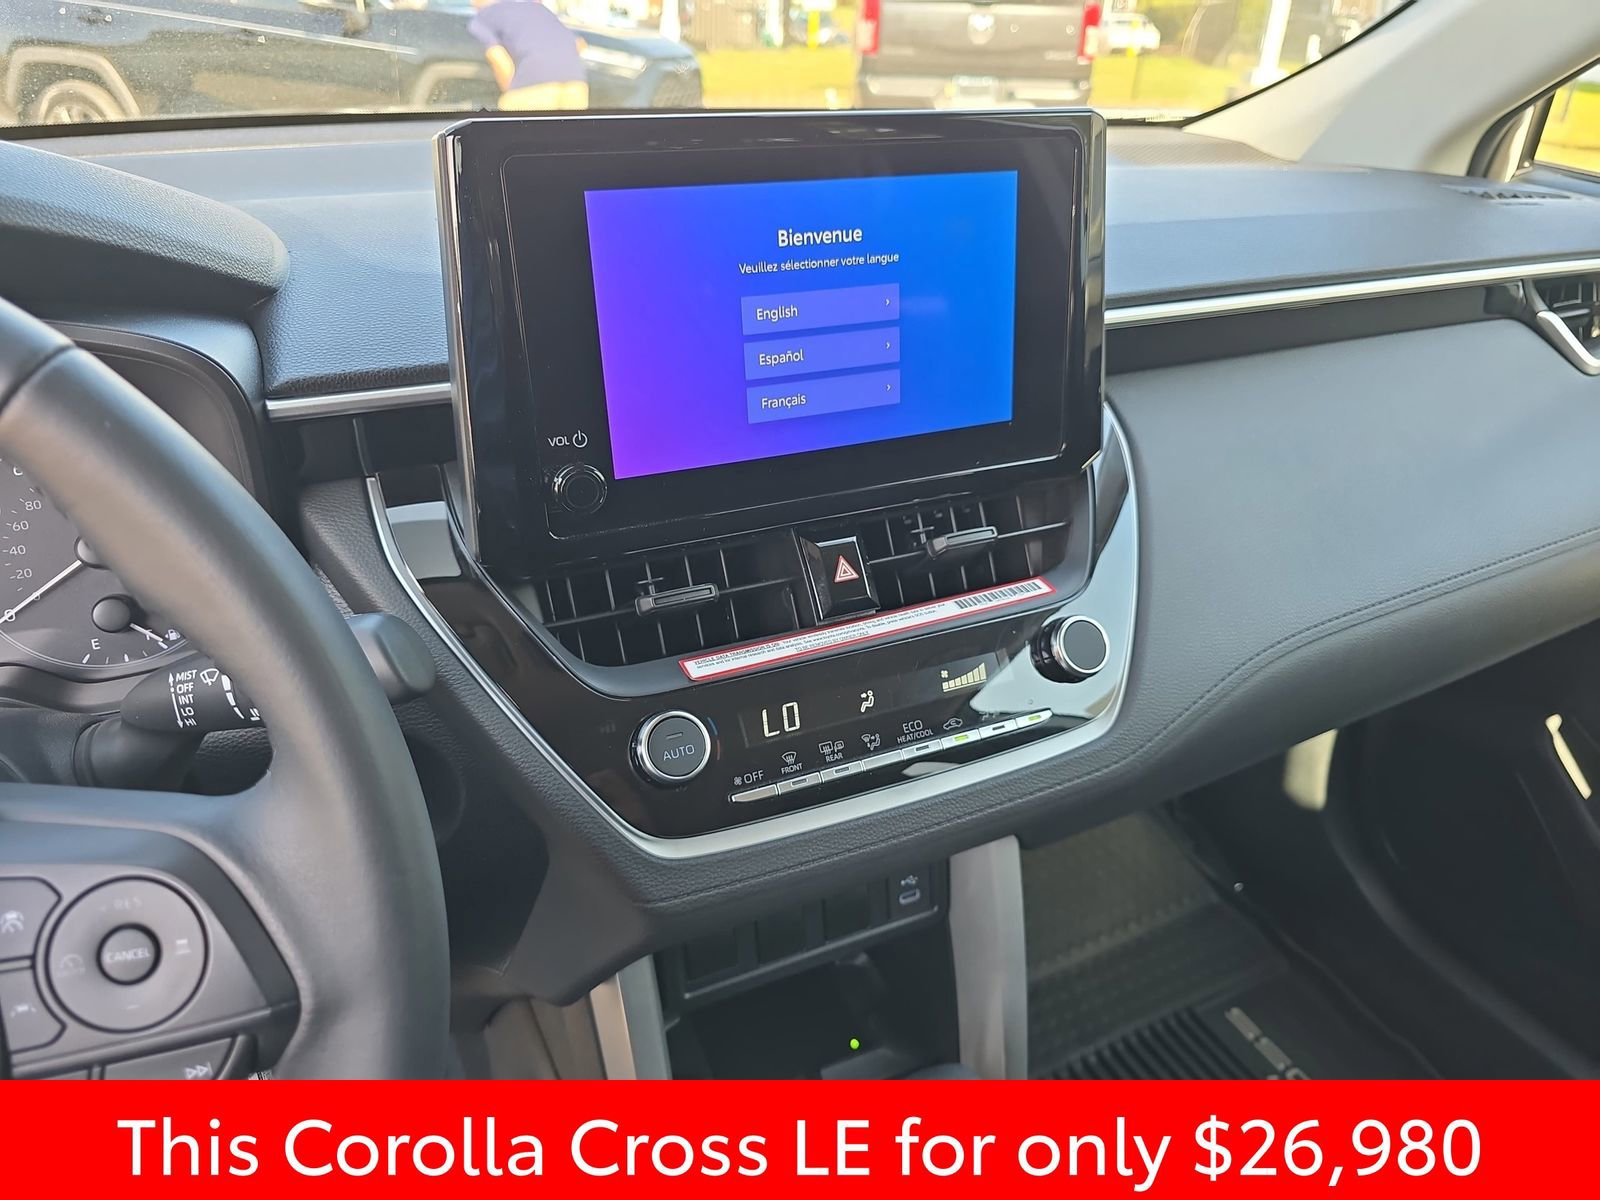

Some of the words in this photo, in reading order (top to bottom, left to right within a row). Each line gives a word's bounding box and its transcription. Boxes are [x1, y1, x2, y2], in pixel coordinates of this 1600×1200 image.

[777, 228, 863, 247] Bienvenue
[739, 260, 778, 274] Veuillez
[781, 257, 839, 271] sélectionner
[841, 255, 865, 267] votre
[867, 253, 900, 266] langue
[756, 305, 798, 322] English
[759, 349, 804, 367] Español
[761, 393, 807, 410] Français
[548, 436, 570, 447] VOL
[25, 500, 42, 511] 80
[12, 520, 29, 532] 60
[9, 545, 26, 556] 40
[15, 568, 33, 580] 20
[90, 638, 101, 650] E
[175, 669, 198, 682] MIST
[176, 682, 194, 694] OFF
[178, 694, 194, 705] INT
[180, 706, 195, 716] LO
[184, 718, 197, 726] HI
[762, 701, 801, 738] LO
[902, 719, 924, 734] ECO
[896, 728, 934, 744] HEAT/COOL
[662, 744, 695, 761] AUTO
[825, 752, 844, 763] REAR
[780, 763, 803, 775] FRONT
[743, 769, 765, 785] OFF
[104, 947, 151, 963] CANCEL
